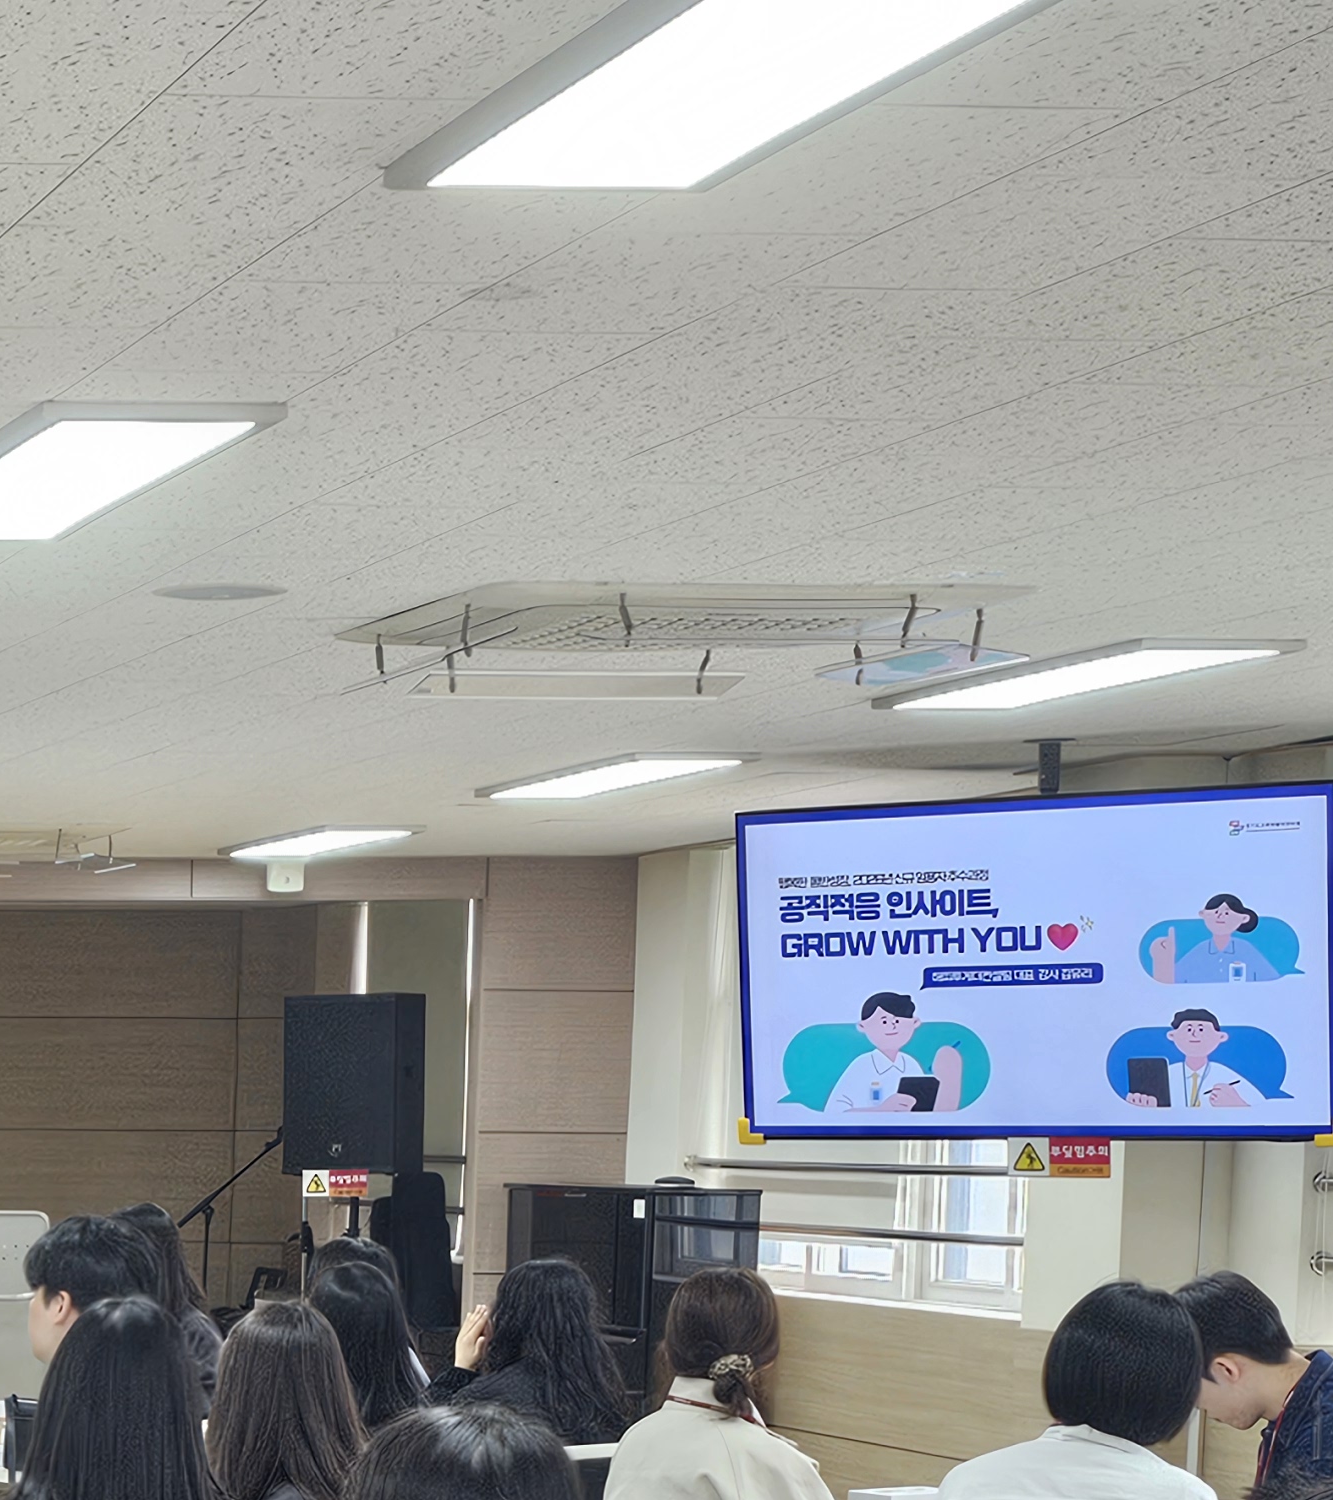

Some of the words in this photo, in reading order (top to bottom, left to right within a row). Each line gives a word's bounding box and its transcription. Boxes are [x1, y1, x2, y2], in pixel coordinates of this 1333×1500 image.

[779, 891, 881, 923] 공직적응
[886, 888, 999, 919] 인사이트,
[781, 930, 877, 958] GROW
[882, 927, 965, 955] WITH
[971, 925, 1042, 952] YOU
